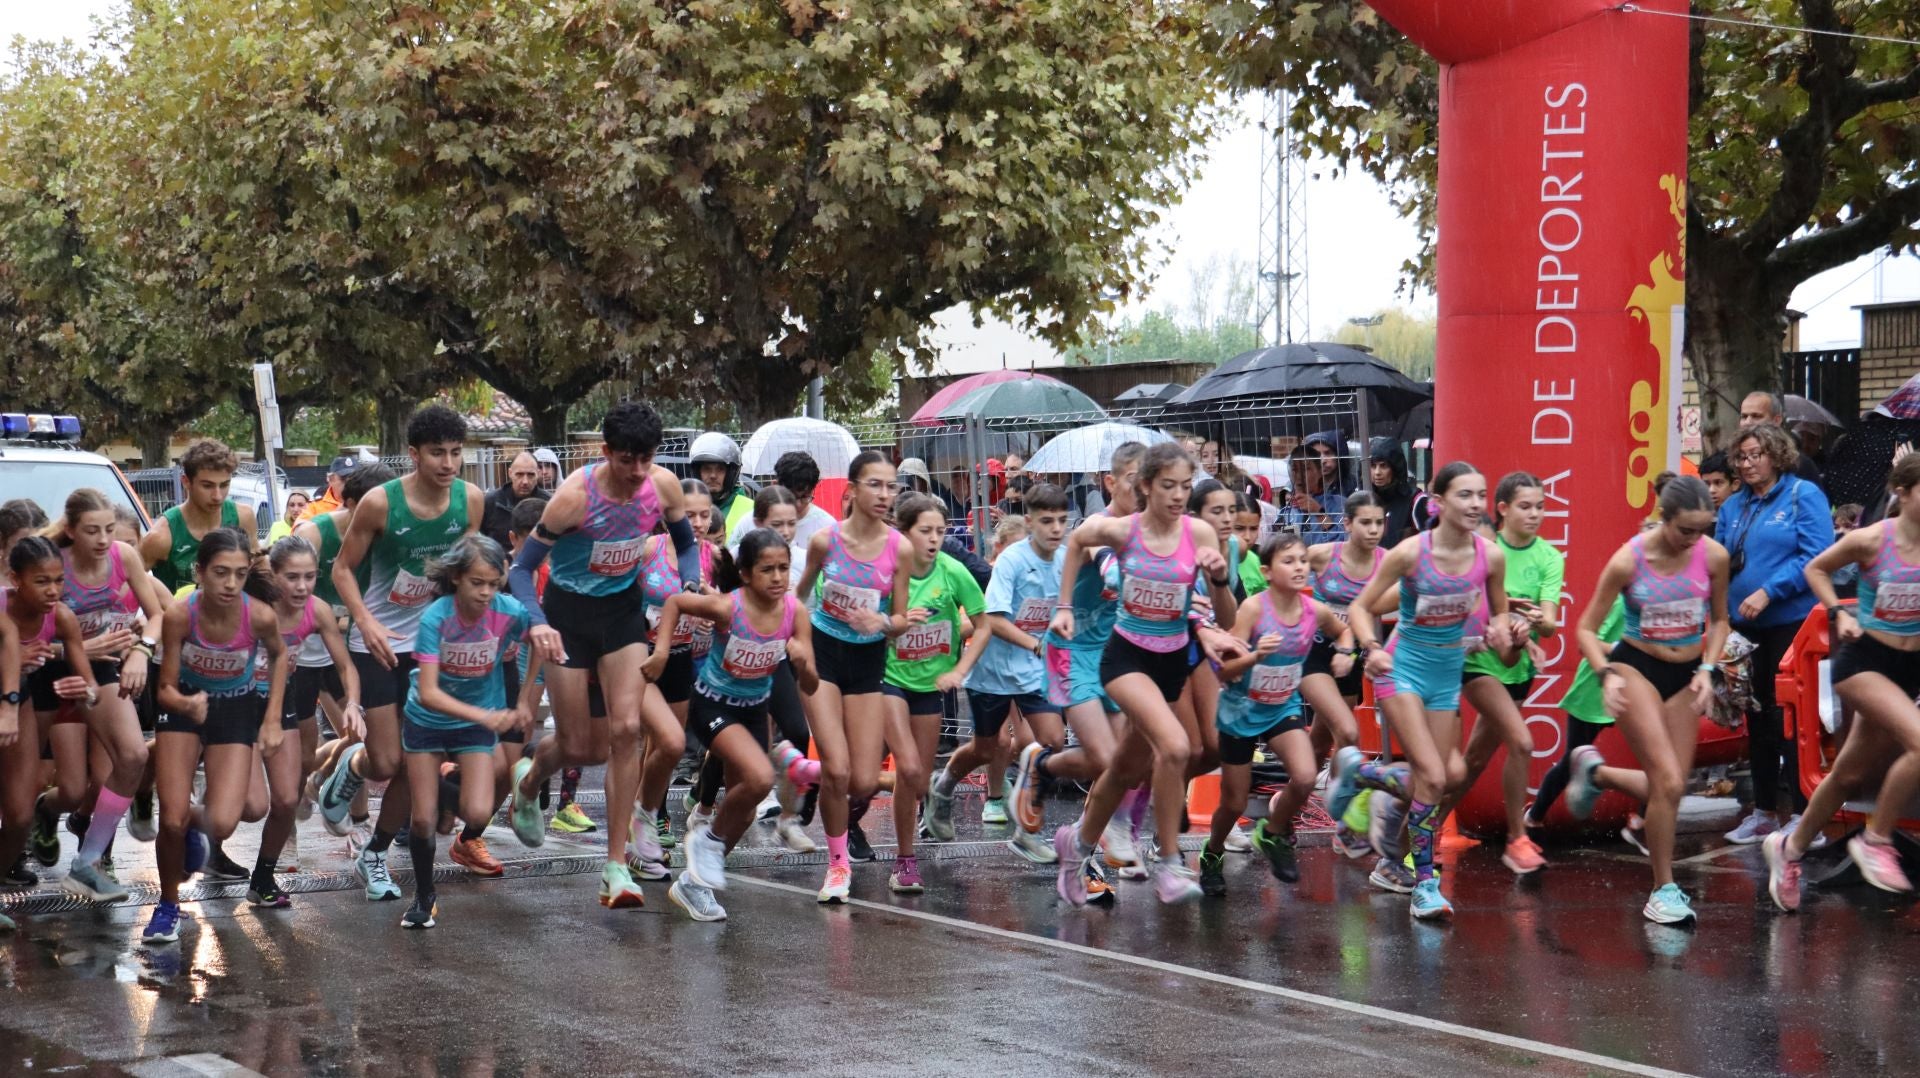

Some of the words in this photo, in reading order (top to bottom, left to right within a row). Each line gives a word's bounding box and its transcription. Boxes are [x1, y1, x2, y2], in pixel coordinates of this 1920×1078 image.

[1535, 82, 1587, 353] DEPORTES
[1531, 379, 1575, 445] DE
[1132, 587, 1175, 608] 2053
[906, 629, 942, 648] 2057
[192, 654, 237, 670] 2037
[447, 650, 489, 666] 2045
[734, 649, 775, 668] 2038
